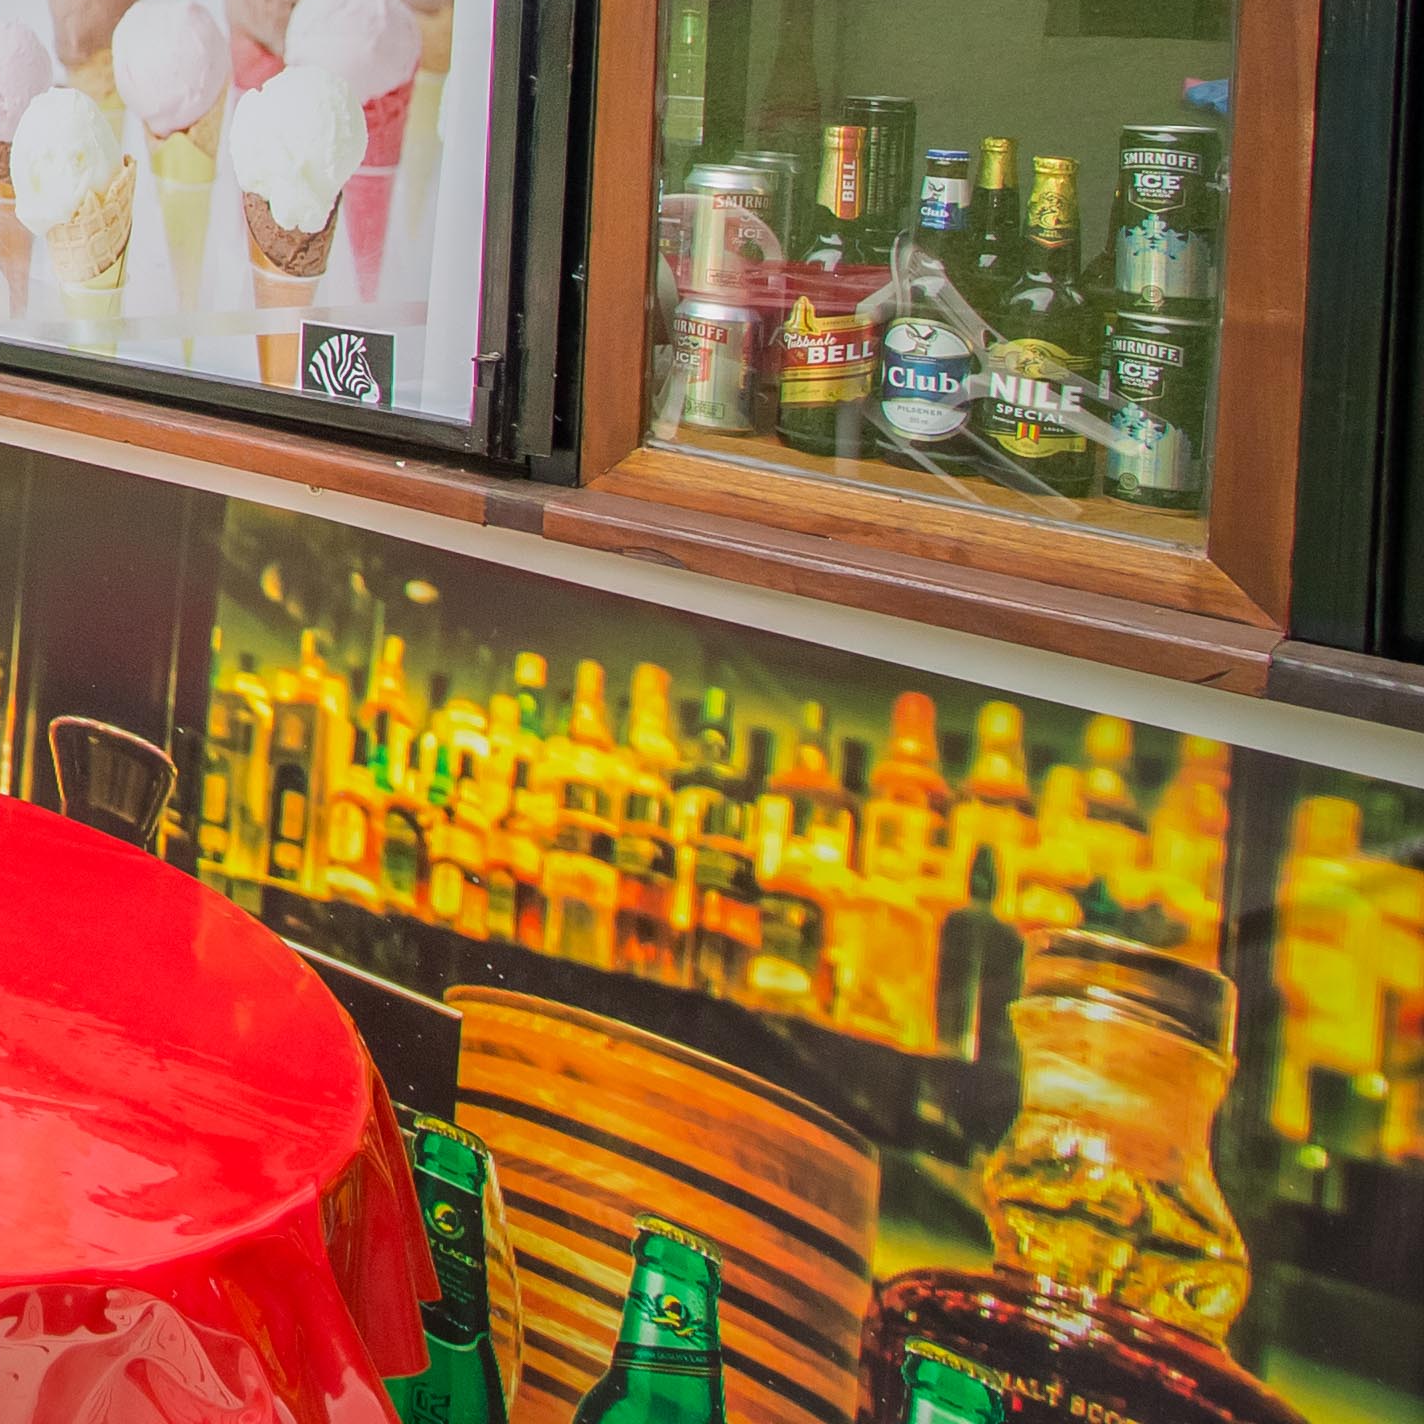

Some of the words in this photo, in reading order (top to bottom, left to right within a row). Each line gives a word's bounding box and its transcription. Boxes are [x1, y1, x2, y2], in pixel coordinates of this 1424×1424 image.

[841, 160, 856, 202] BELL
[1133, 173, 1181, 189] ICE
[716, 195, 769, 208] SMIRNO
[920, 206, 950, 217] Club
[738, 228, 765, 239] ICE
[675, 351, 701, 366] ICE
[807, 340, 874, 364] BELL
[888, 366, 960, 394] Club
[1117, 360, 1160, 381] ICE
[990, 371, 1083, 412] NILE
[995, 403, 1067, 425] SPECIAL
